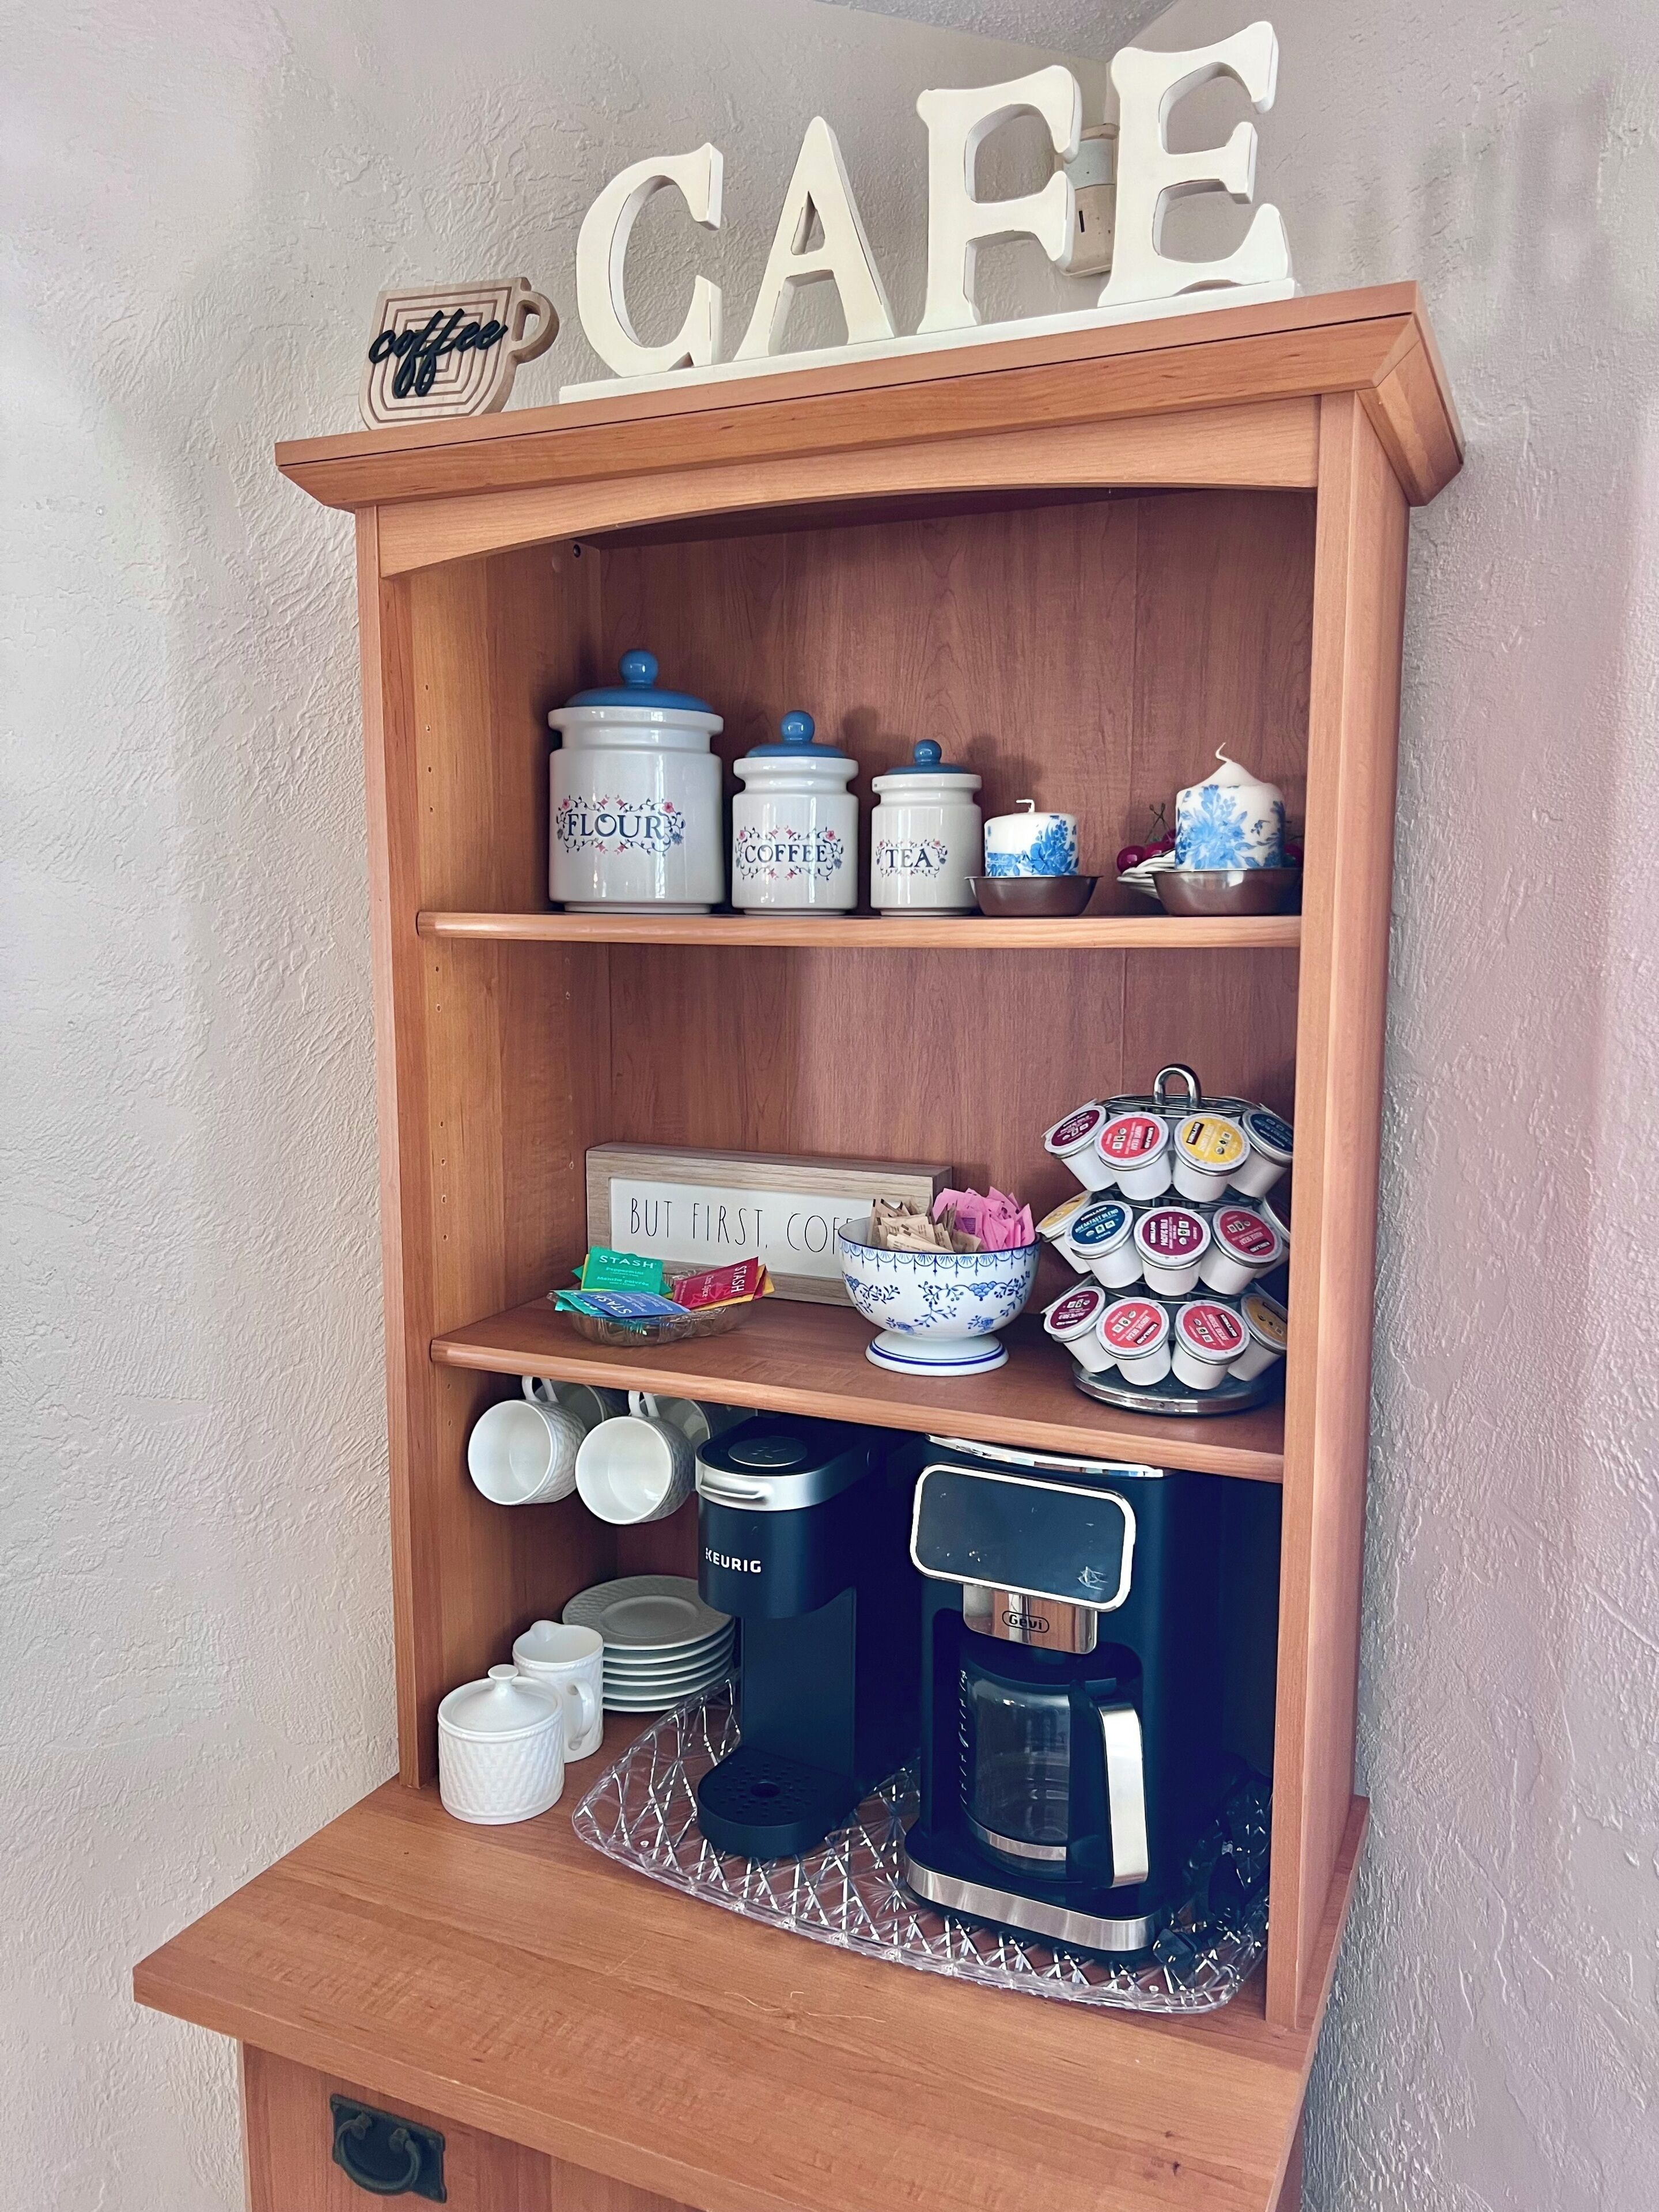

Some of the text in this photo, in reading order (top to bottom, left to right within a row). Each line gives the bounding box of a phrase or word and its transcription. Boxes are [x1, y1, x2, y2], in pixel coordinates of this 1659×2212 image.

[577, 21, 1292, 378] CAFE
[369, 308, 508, 399] coffee
[567, 813, 665, 839] FLOUR
[744, 843, 827, 863] COFFEE
[885, 847, 933, 868] TEA
[631, 1198, 672, 1238] BUT
[787, 1213, 853, 1254] COF
[1075, 1216, 1101, 1233] BREAKFAST
[1101, 1209, 1119, 1219] BLEND
[1160, 1219, 1168, 1246] PACIFIC BOLD
[599, 1255, 653, 1268] STASH
[730, 1266, 747, 1293] STASH
[590, 1294, 632, 1314] STASH
[1137, 1324, 1158, 1344] KIRKLAND
[1215, 1328, 1229, 1341] DECAF
[1220, 1314, 1237, 1337] KIRKLAND
[706, 1547, 761, 1573] KEURIG
[1009, 1614, 1042, 1630] Gevi
